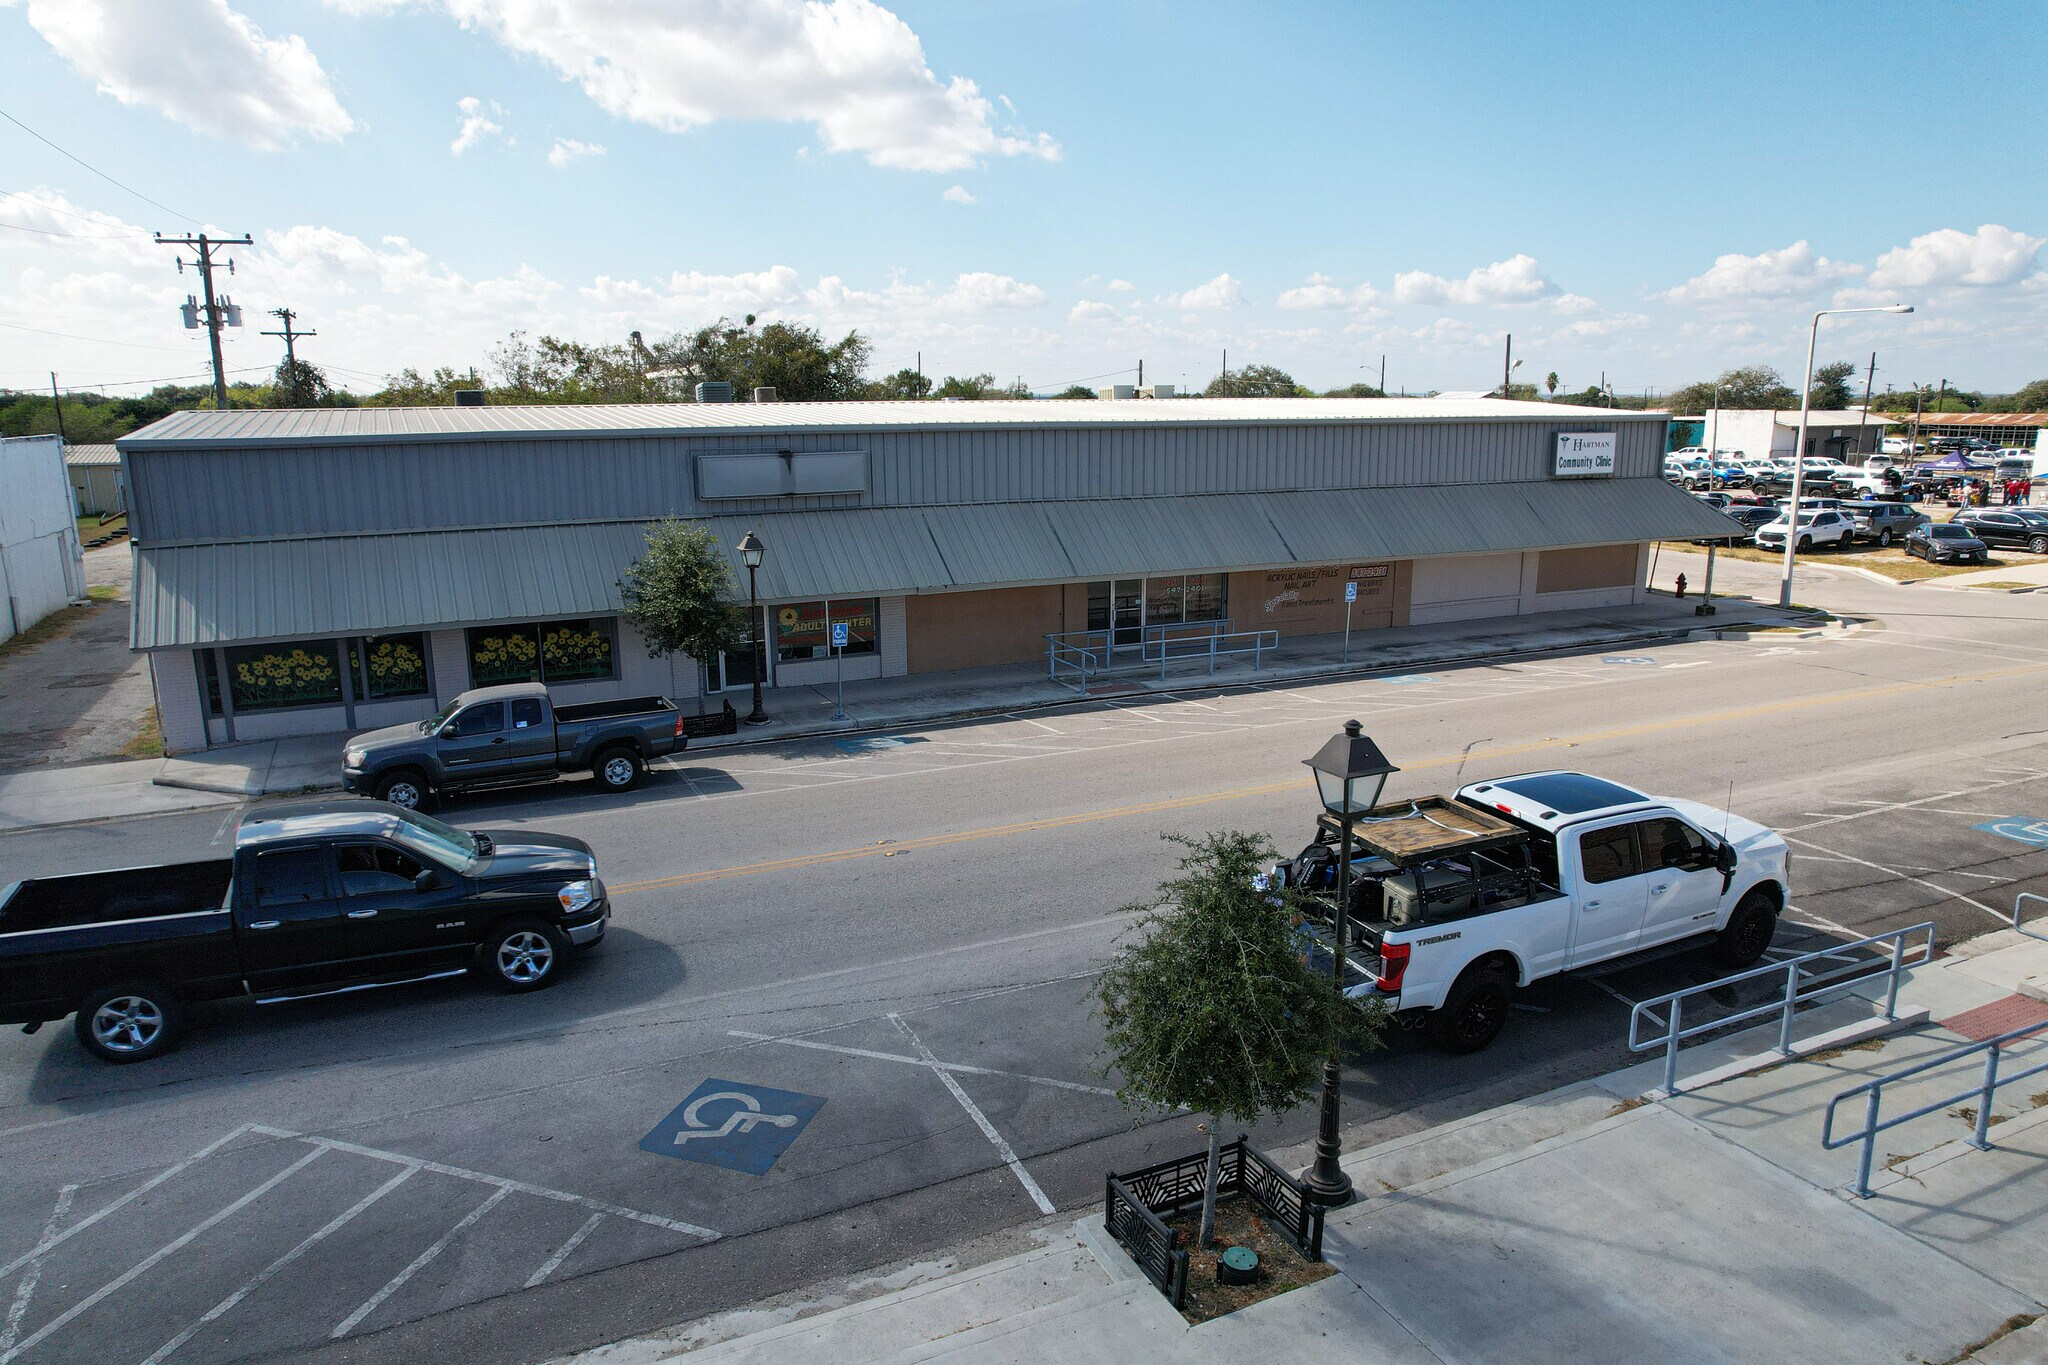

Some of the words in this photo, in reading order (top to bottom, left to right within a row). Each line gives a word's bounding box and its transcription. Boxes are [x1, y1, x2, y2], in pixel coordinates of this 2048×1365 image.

[1573, 439, 1609, 451] HARTMAN
[1559, 456, 1592, 469] Community
[1596, 455, 1611, 467] Clinic
[1266, 572, 1296, 583] ACRYLIC
[1284, 582, 1300, 590] NAIL
[1301, 579, 1316, 589] ART
[1264, 590, 1300, 613] Specialty
[1298, 597, 1335, 607] Treatments
[792, 621, 825, 632] ADULT
[436, 921, 465, 929] RAM
[1416, 931, 1462, 947] TREMOR
